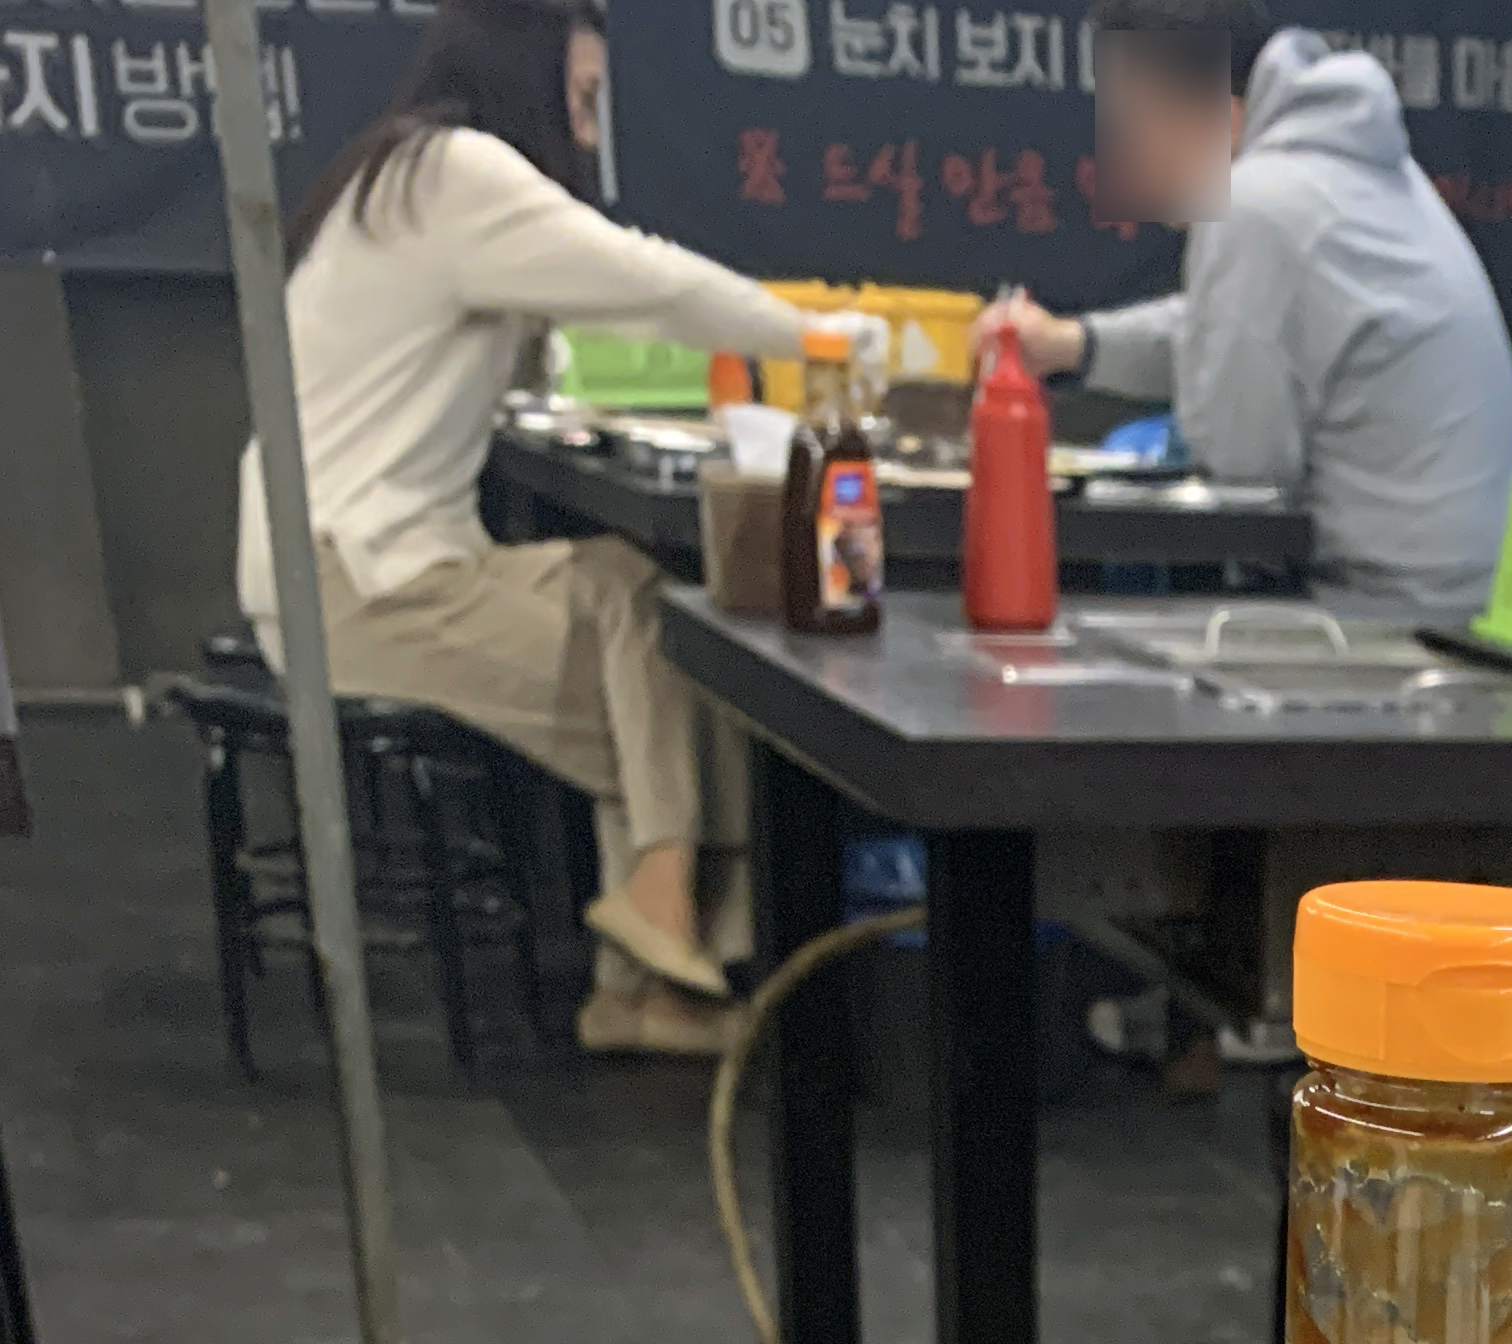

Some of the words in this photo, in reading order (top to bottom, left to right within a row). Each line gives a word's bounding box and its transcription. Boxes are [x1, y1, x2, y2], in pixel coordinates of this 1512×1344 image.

[0, 32, 99, 138] 지
[729, 0, 797, 51] 05
[829, 0, 941, 83] 눈치
[953, 8, 1066, 92] 보지
